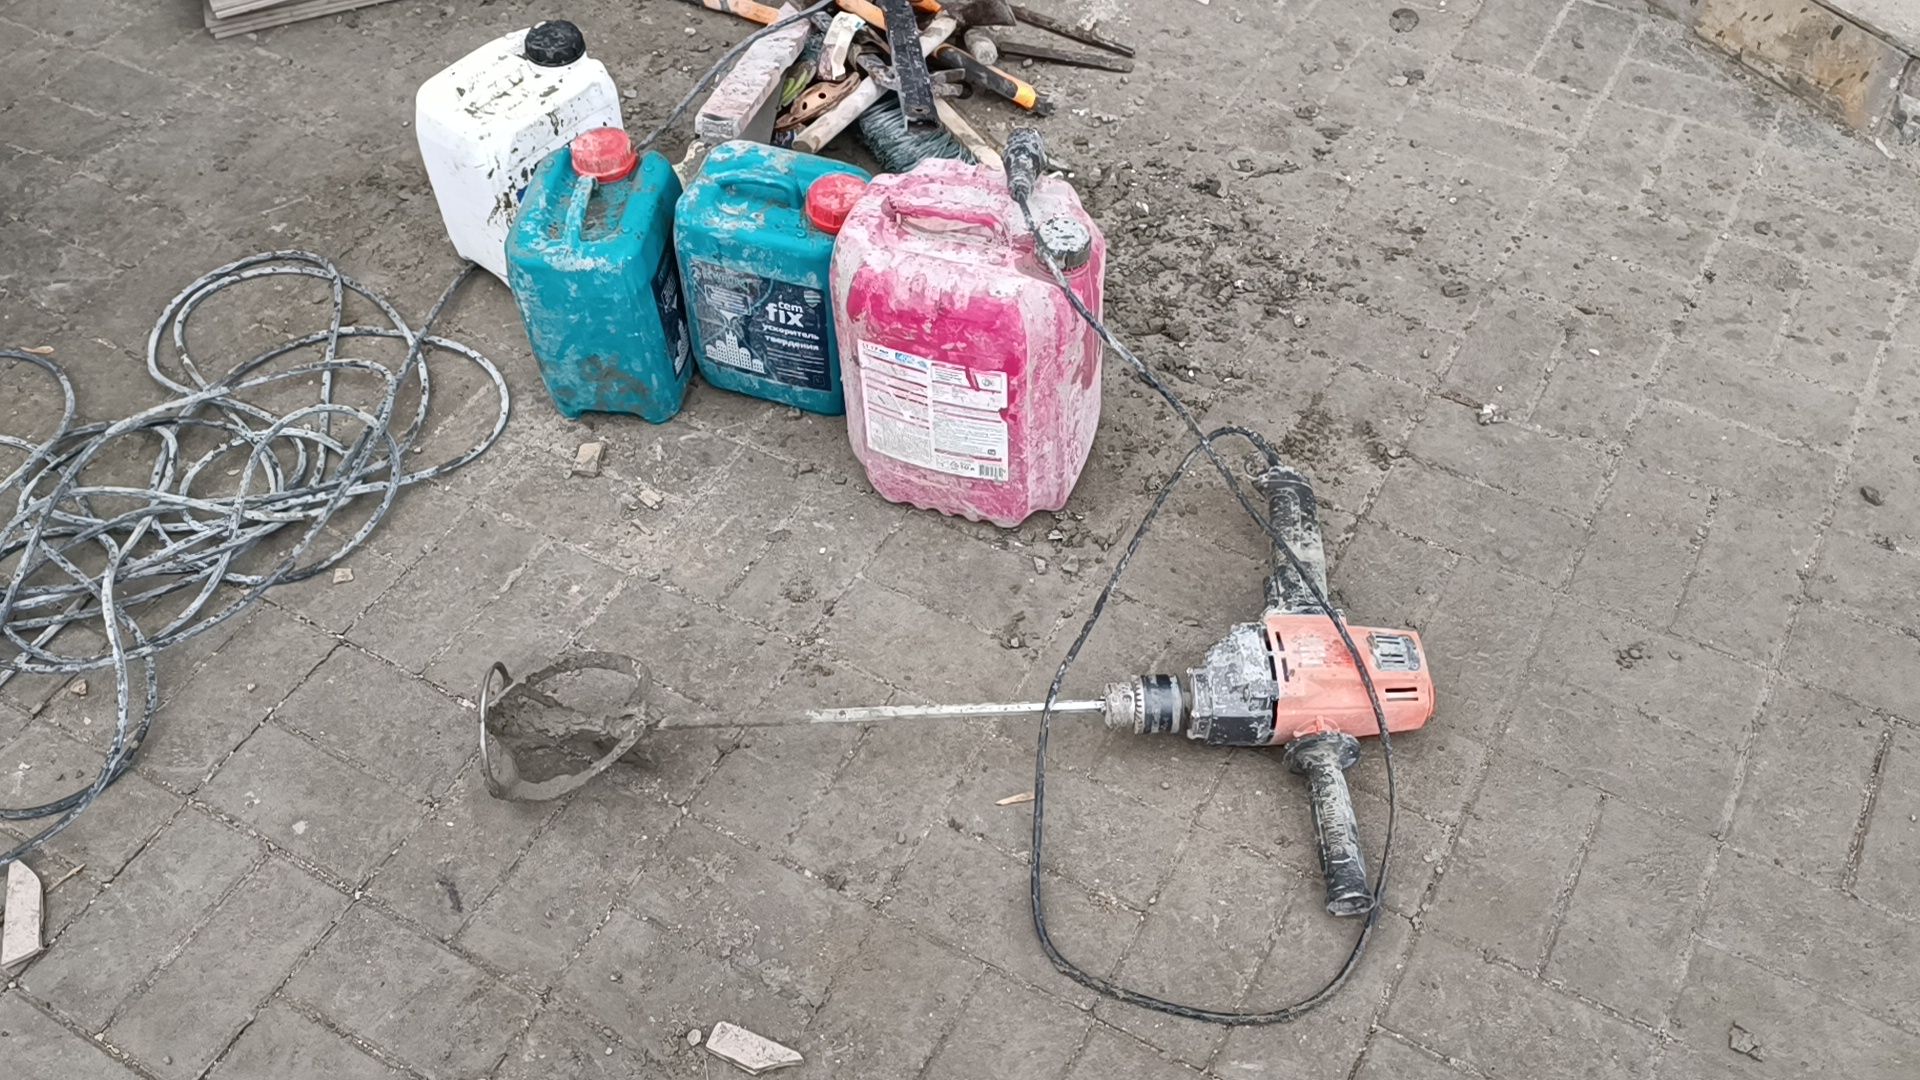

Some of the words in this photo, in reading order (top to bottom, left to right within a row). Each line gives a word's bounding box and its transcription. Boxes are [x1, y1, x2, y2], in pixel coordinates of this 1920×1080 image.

[765, 303, 804, 327] fix
[762, 323, 819, 340] ускоритель
[764, 335, 819, 350] твердения
